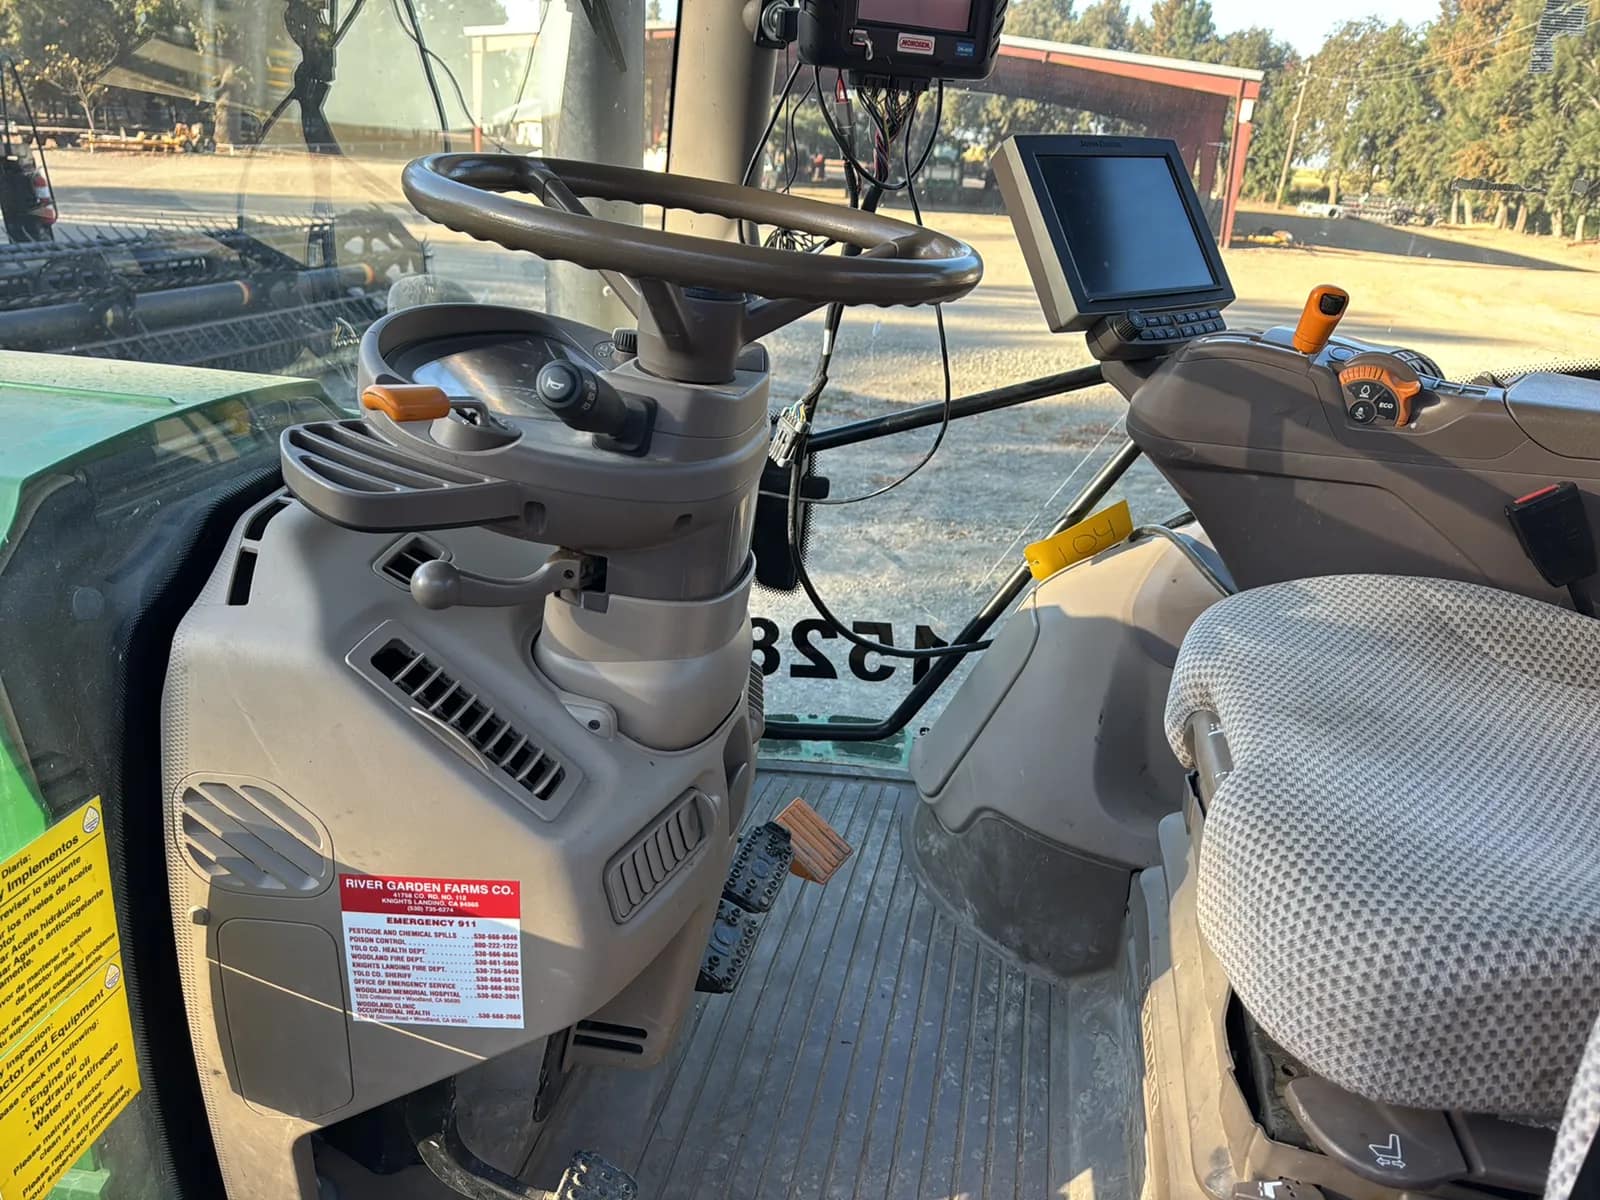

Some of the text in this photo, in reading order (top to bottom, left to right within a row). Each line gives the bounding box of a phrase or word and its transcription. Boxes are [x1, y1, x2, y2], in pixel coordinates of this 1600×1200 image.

[7, 835, 78, 892] Implementos
[33, 886, 41, 896] lo
[43, 856, 81, 888] siguiente
[7, 863, 92, 932] los niveles de Aceite
[345, 878, 515, 896] RIVER GARDEN FARMS CO.
[381, 898, 412, 906] KNIGHTS
[13, 944, 36, 967] Agua
[46, 889, 103, 940] anticongelante
[386, 916, 477, 928] EMERGENCY 911
[407, 905, 423, 913] (530)
[12, 929, 38, 955] Aceite
[349, 927, 382, 935] PESTICIDE
[399, 930, 432, 938] CHEMICAL
[434, 931, 457, 939] SPILLS
[375, 937, 406, 945] CONTROL
[382, 946, 407, 954] HEALTH
[16, 982, 26, 993] de
[27, 952, 60, 984] mantener
[62, 946, 68, 954] la
[351, 953, 389, 961] WOODLAND
[412, 964, 427, 972] FIRE
[12, 1015, 21, 1026] de
[22, 987, 51, 1017] reportar
[53, 958, 84, 989] cualquier
[86, 932, 115, 962] problema
[16, 991, 27, 1005] del
[28, 970, 52, 994] tractor
[353, 978, 376, 986] OFFICE
[387, 980, 427, 988] EMERGENCY
[428, 982, 456, 990] SERVICE
[393, 988, 428, 996] MEMORIAL
[429, 990, 461, 998] HOSPITAL
[9, 1002, 47, 1039] supervisor
[28, 1040, 48, 1066] and
[51, 989, 104, 1044] Equipment
[357, 1007, 405, 1015] OCCUPATIONAL
[406, 1009, 431, 1017] HEALTH
[21, 1070, 46, 1099] check
[47, 1057, 60, 1072] the
[62, 1020, 99, 1058] following:
[30, 1055, 77, 1107] Engine oil
[32, 1055, 90, 1120] Hydraulic oil
[34, 1042, 118, 1131] Water or antifreeze
[13, 1058, 123, 1176] Please maintain tractor cabin
[40, 1136, 61, 1160] clean
[63, 1125, 70, 1136] at
[71, 1112, 81, 1126] all
[22, 1084, 124, 1198] Please report any problems
[47, 1136, 88, 1183] supervisor
